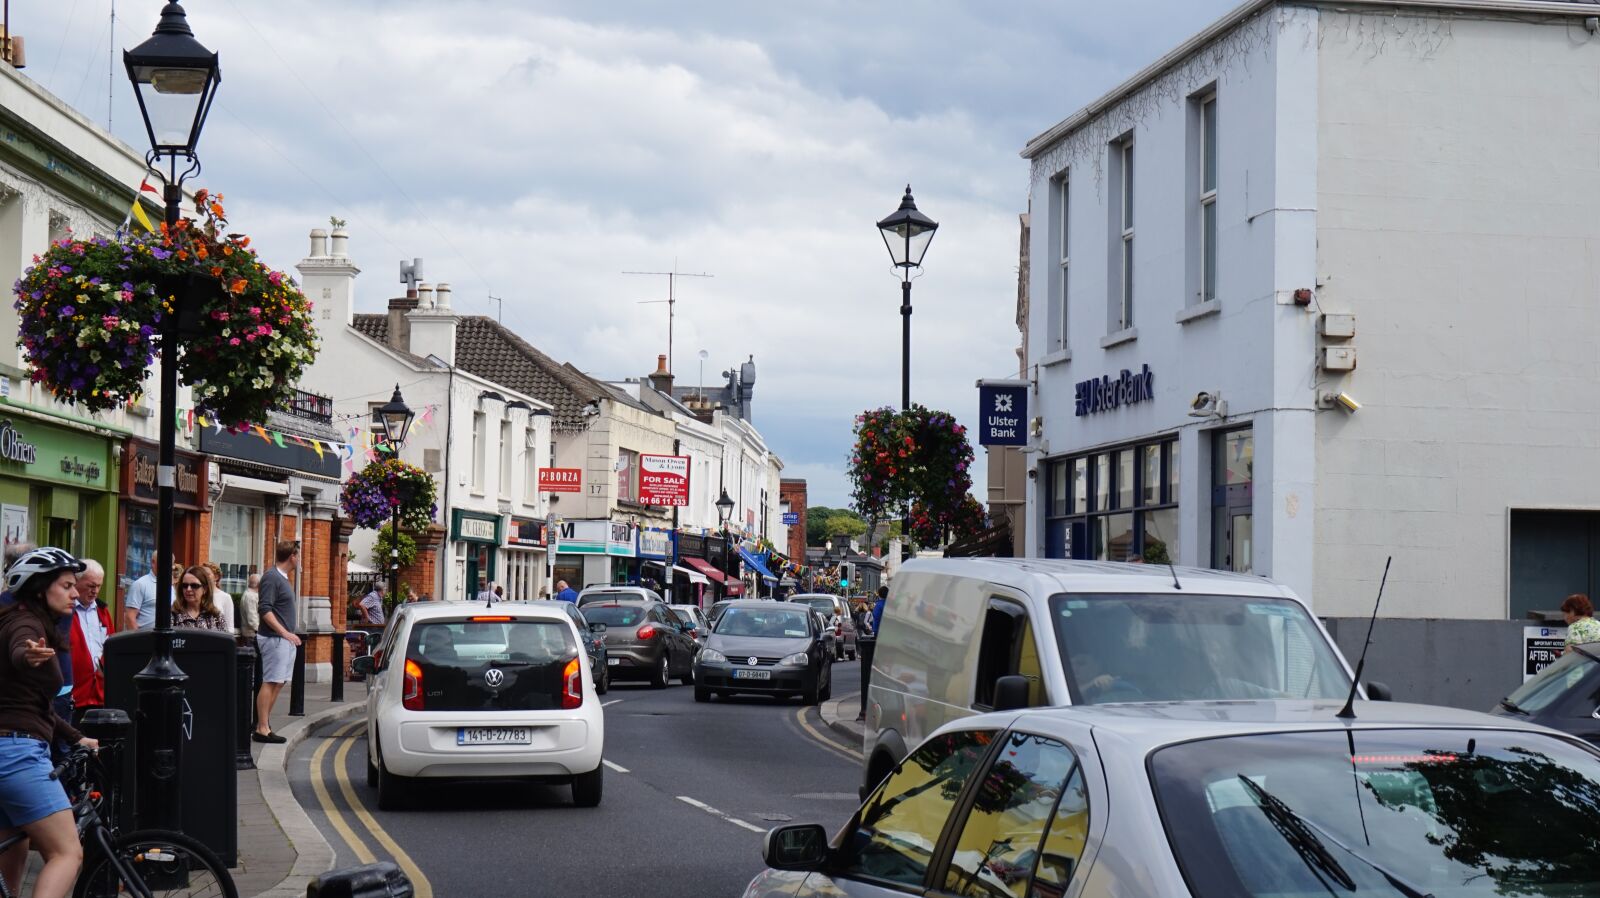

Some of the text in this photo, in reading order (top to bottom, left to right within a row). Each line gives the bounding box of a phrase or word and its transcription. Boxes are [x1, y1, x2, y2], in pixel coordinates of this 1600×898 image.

[1086, 364, 1153, 413] Ulster Bank
[988, 416, 1018, 427] Ulster
[990, 428, 1016, 438] Bank
[591, 485, 601, 494] 17
[1529, 650, 1549, 661] AFTER
[467, 728, 526, 741] 141-D-27783
